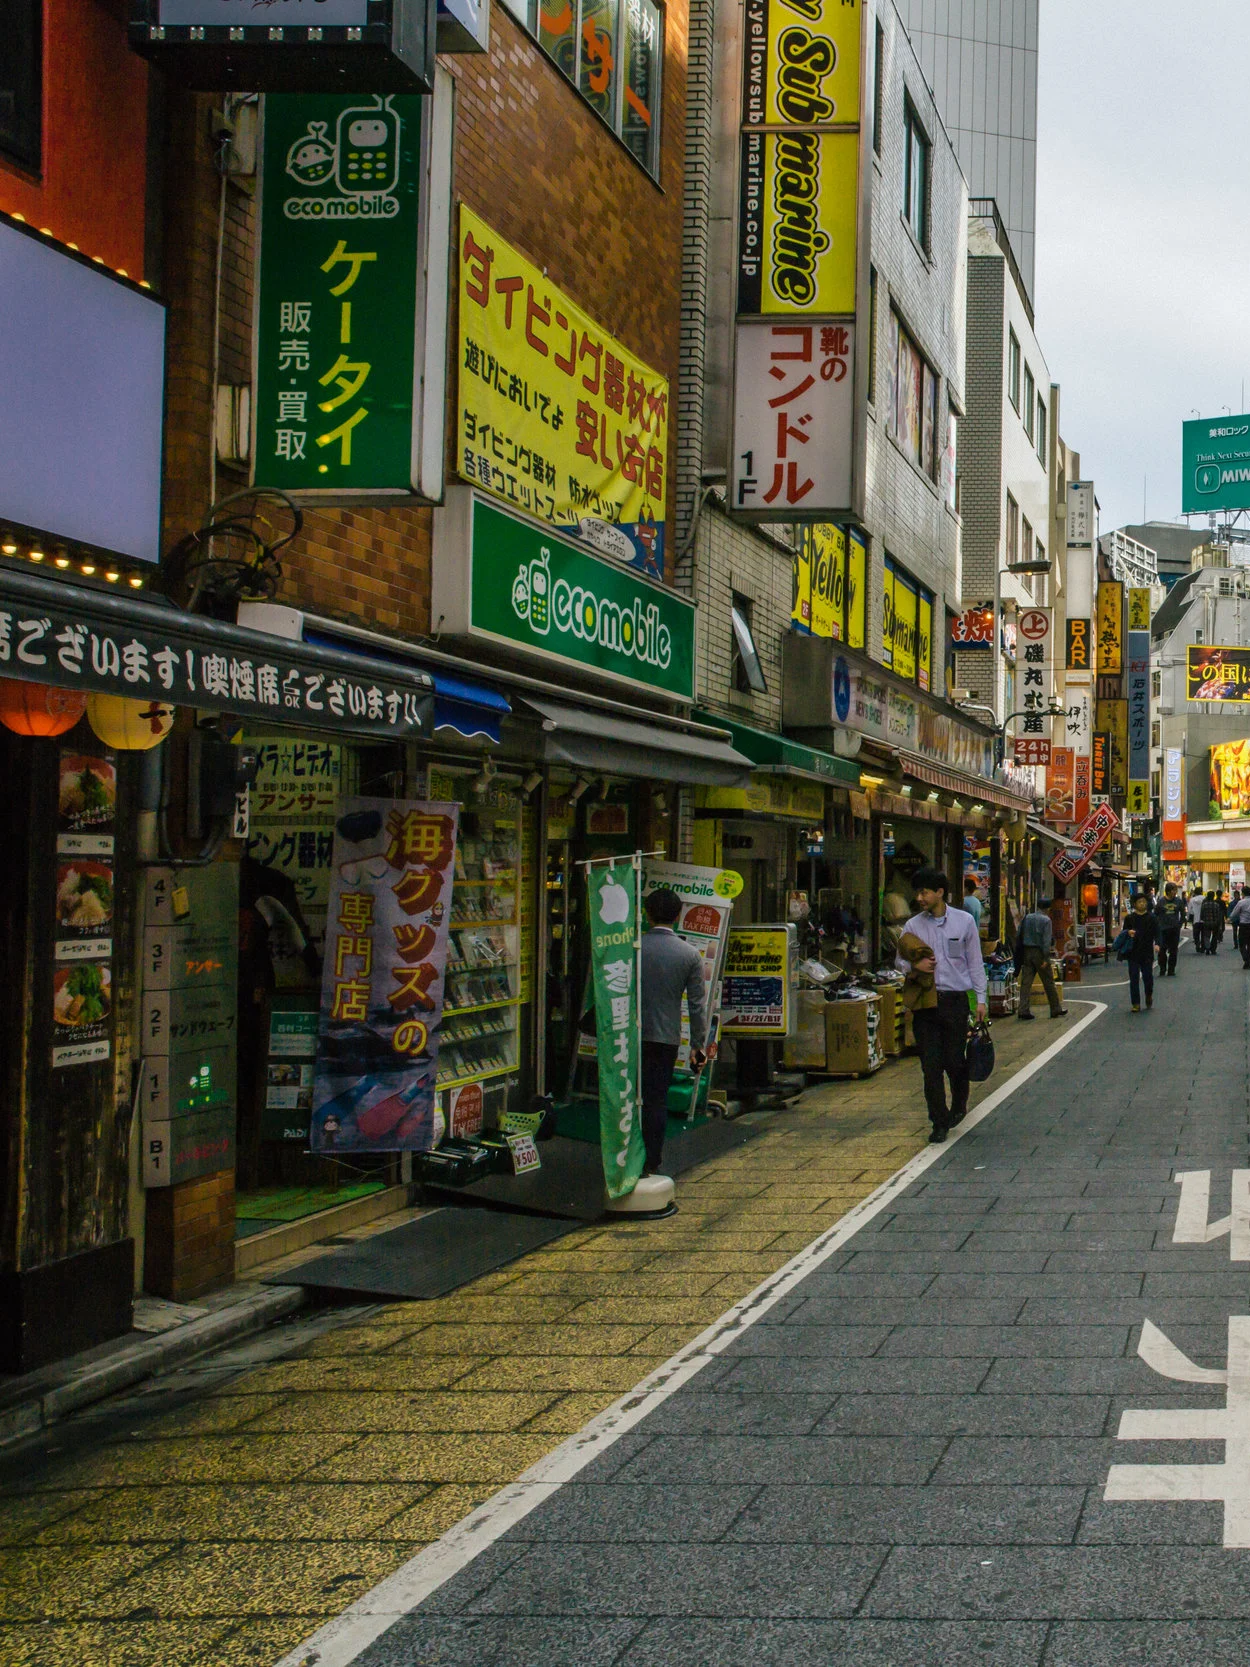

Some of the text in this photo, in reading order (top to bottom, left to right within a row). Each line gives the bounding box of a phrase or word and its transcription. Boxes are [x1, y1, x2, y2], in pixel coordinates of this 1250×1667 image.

[739, 0, 767, 277] .yellowsubmarine.co.jp
[315, 239, 378, 466] ケータイ
[819, 326, 849, 383] 靴の
[762, 326, 816, 505] コンドル
[1208, 424, 1250, 439] 美和ロック
[1195, 452, 1217, 463] Think
[1217, 450, 1233, 460] Next
[552, 578, 672, 670] ecomobile
[1069, 619, 1087, 666] BAR
[1022, 643, 1046, 734] 磯丸水産
[1132, 678, 1147, 752] 石井スポーツ
[1015, 740, 1050, 752] 24h
[1056, 813, 1109, 879] 中華理
[332, 891, 376, 1023] 専門店
